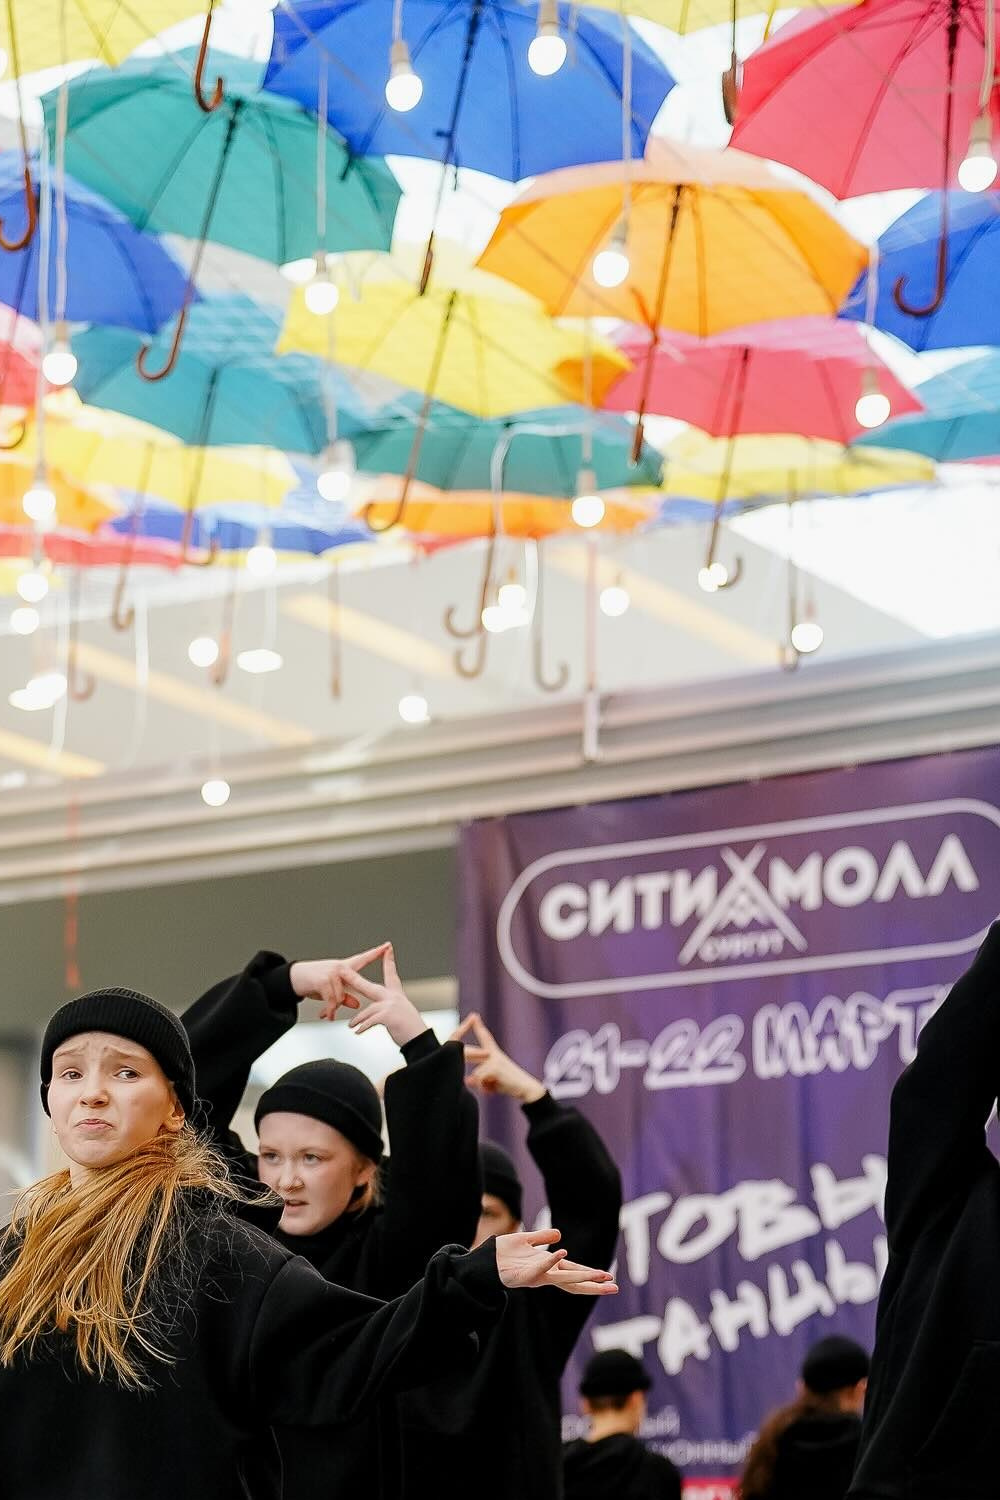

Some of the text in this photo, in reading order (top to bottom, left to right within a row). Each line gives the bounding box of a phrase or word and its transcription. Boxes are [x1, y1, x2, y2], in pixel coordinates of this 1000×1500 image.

[545, 984, 953, 1099] 21-22 МАРТ
[612, 1153, 888, 1286] ТОВЫ
[591, 1235, 889, 1376] ТАНЦЫ
